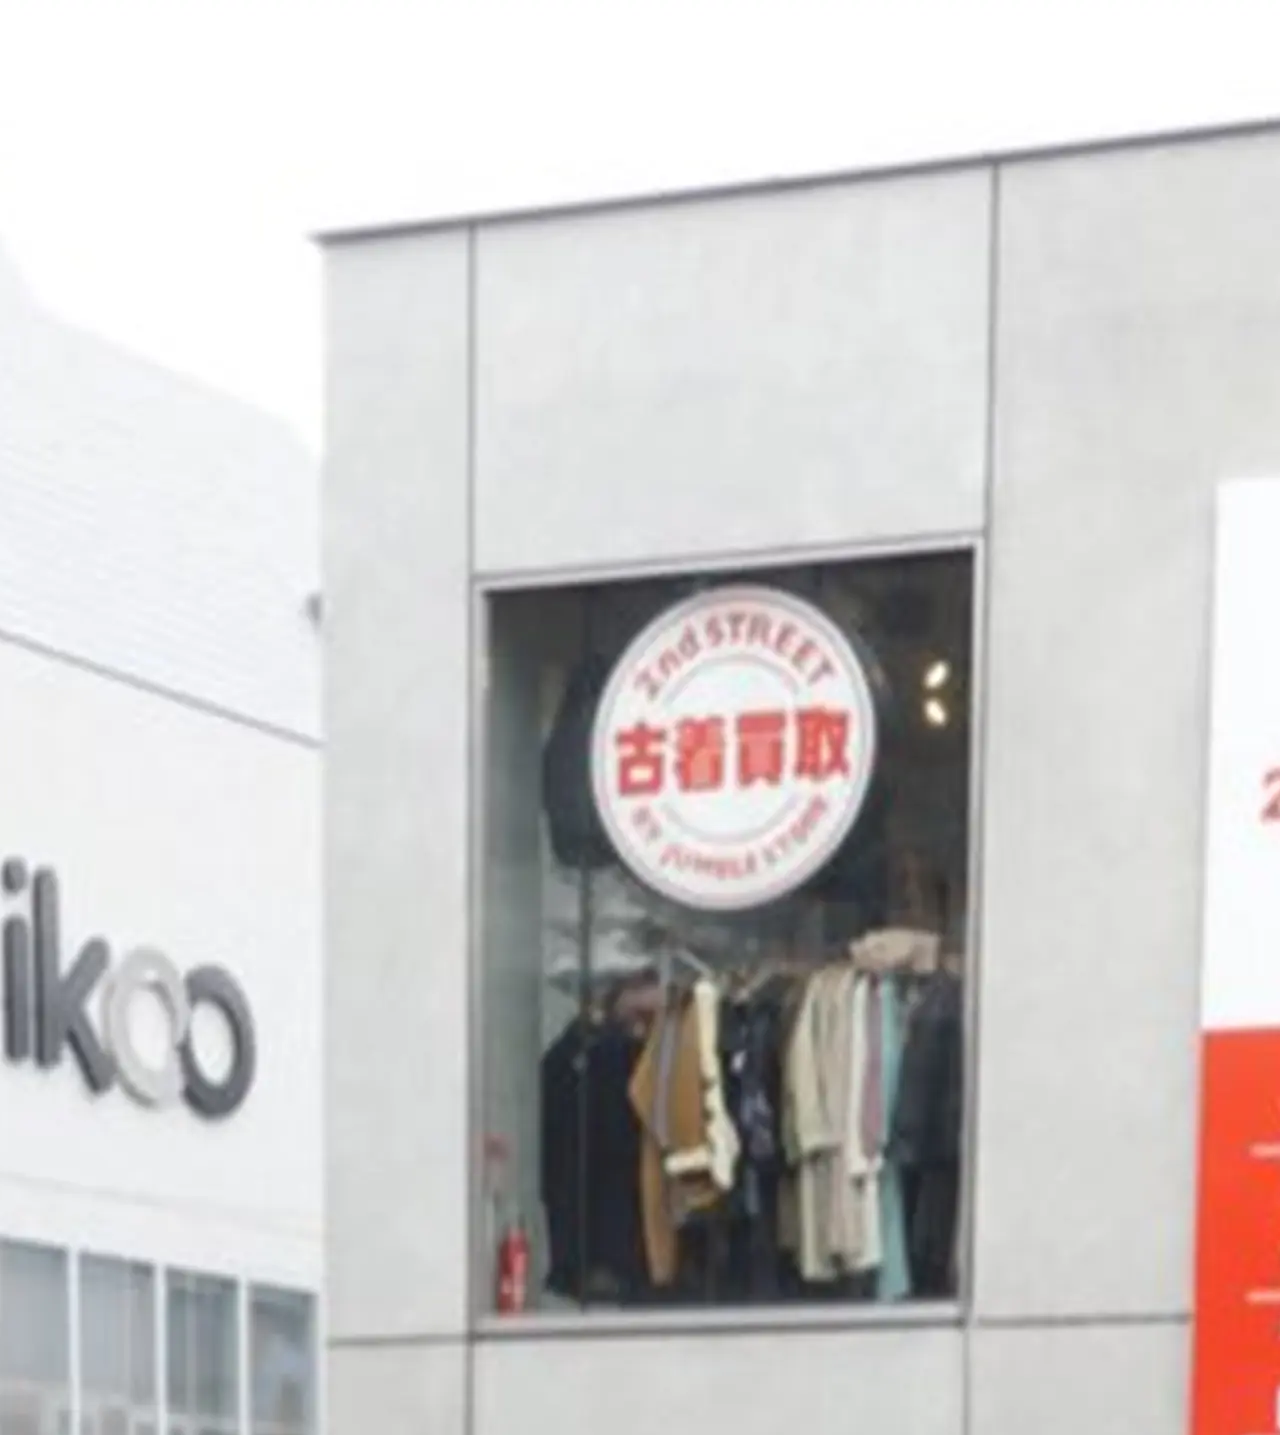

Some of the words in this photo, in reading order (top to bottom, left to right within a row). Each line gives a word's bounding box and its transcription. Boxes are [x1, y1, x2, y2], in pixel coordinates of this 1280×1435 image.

[704, 611, 837, 684] STREET
[615, 704, 850, 797] 古着買取
